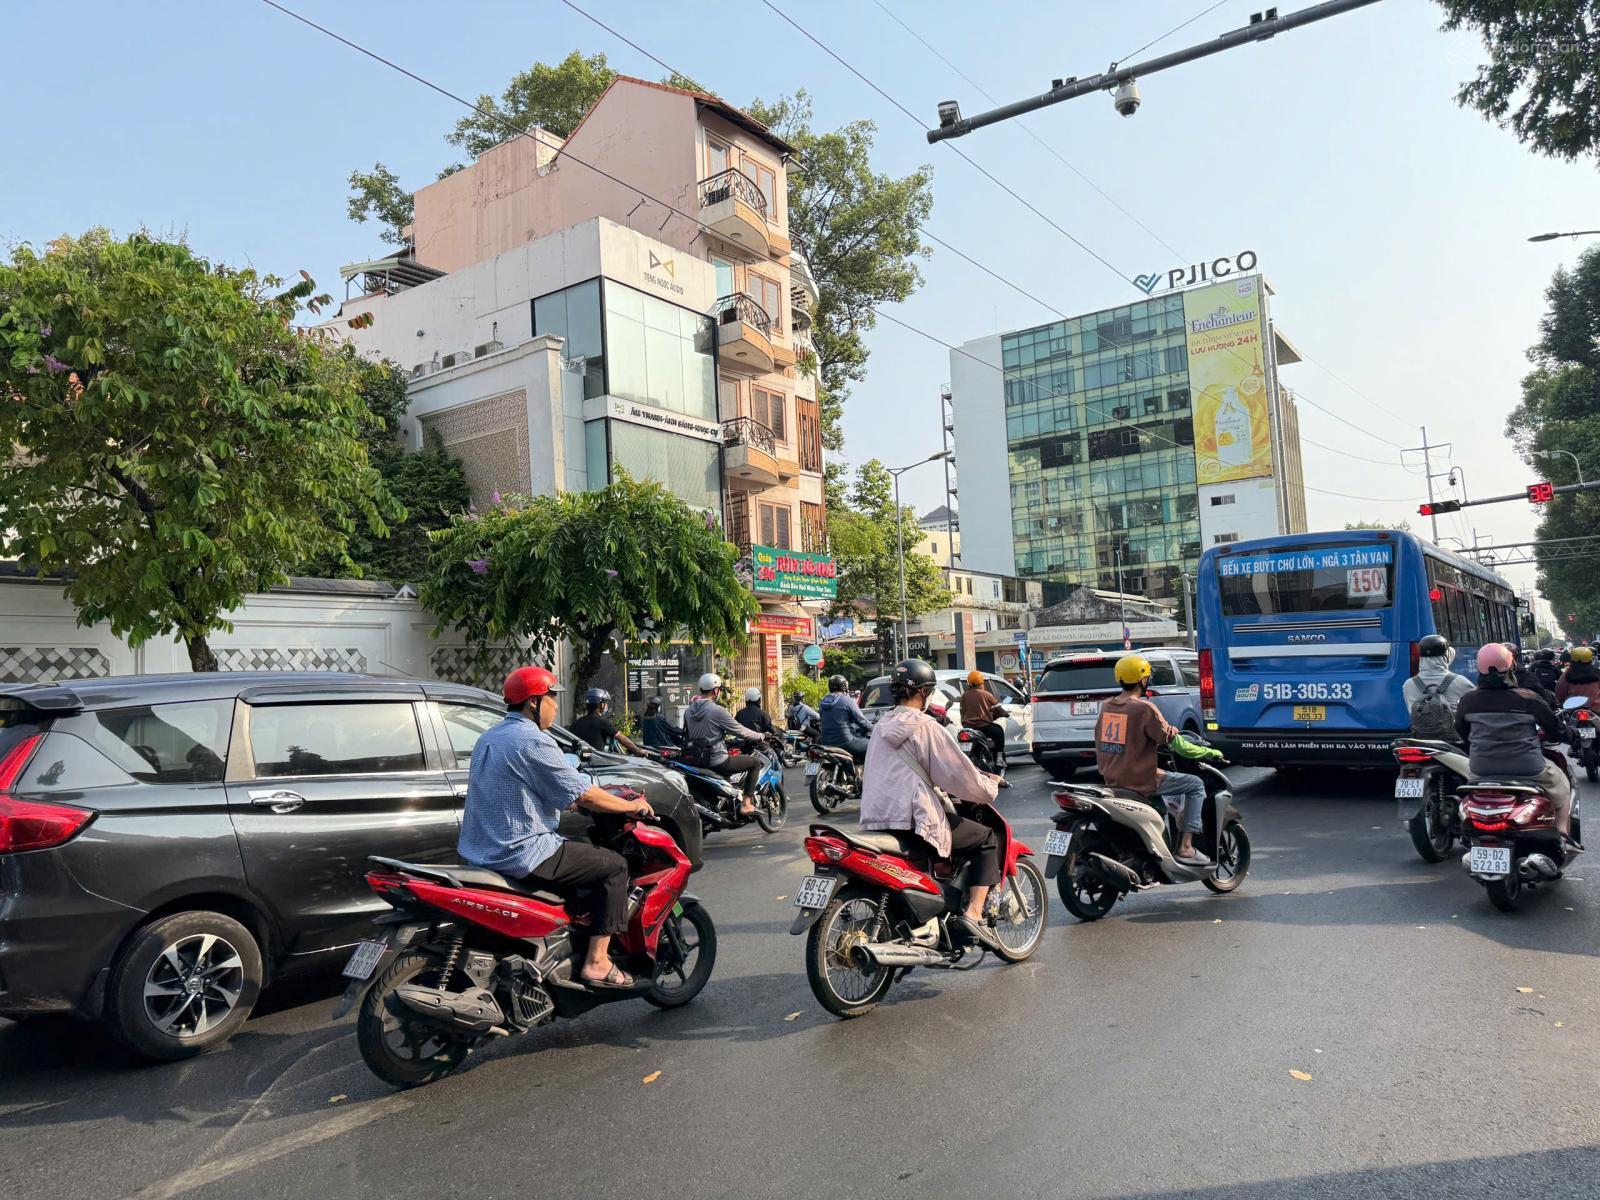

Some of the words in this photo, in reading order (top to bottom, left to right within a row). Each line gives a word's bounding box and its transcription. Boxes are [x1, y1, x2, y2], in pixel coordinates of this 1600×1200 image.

[1168, 250, 1258, 289] PJICO
[1191, 311, 1256, 332] Enchanteur
[1237, 334, 1258, 346] 24H
[1529, 485, 1552, 502] 32
[1222, 559, 1239, 576] BẾN
[1241, 562, 1252, 575] XE
[1253, 558, 1276, 573] BUÝT
[1277, 556, 1295, 572] CHỢ
[1297, 554, 1314, 569] LỚN
[1322, 552, 1340, 568] NGÃ
[1342, 554, 1348, 567] 3
[1350, 550, 1368, 566] TÂN
[1370, 550, 1389, 565] VẠN
[1352, 569, 1382, 593] 150
[1287, 634, 1326, 642] SAMCO
[1263, 683, 1353, 700] 51B-305.33
[1104, 721, 1121, 742] 41
[1281, 741, 1296, 749] LÀM
[1349, 741, 1365, 750] VÀO
[1368, 743, 1389, 751] TRẠM
[1472, 859, 1507, 871] 522.83
[804, 878, 829, 893] 60-C2
